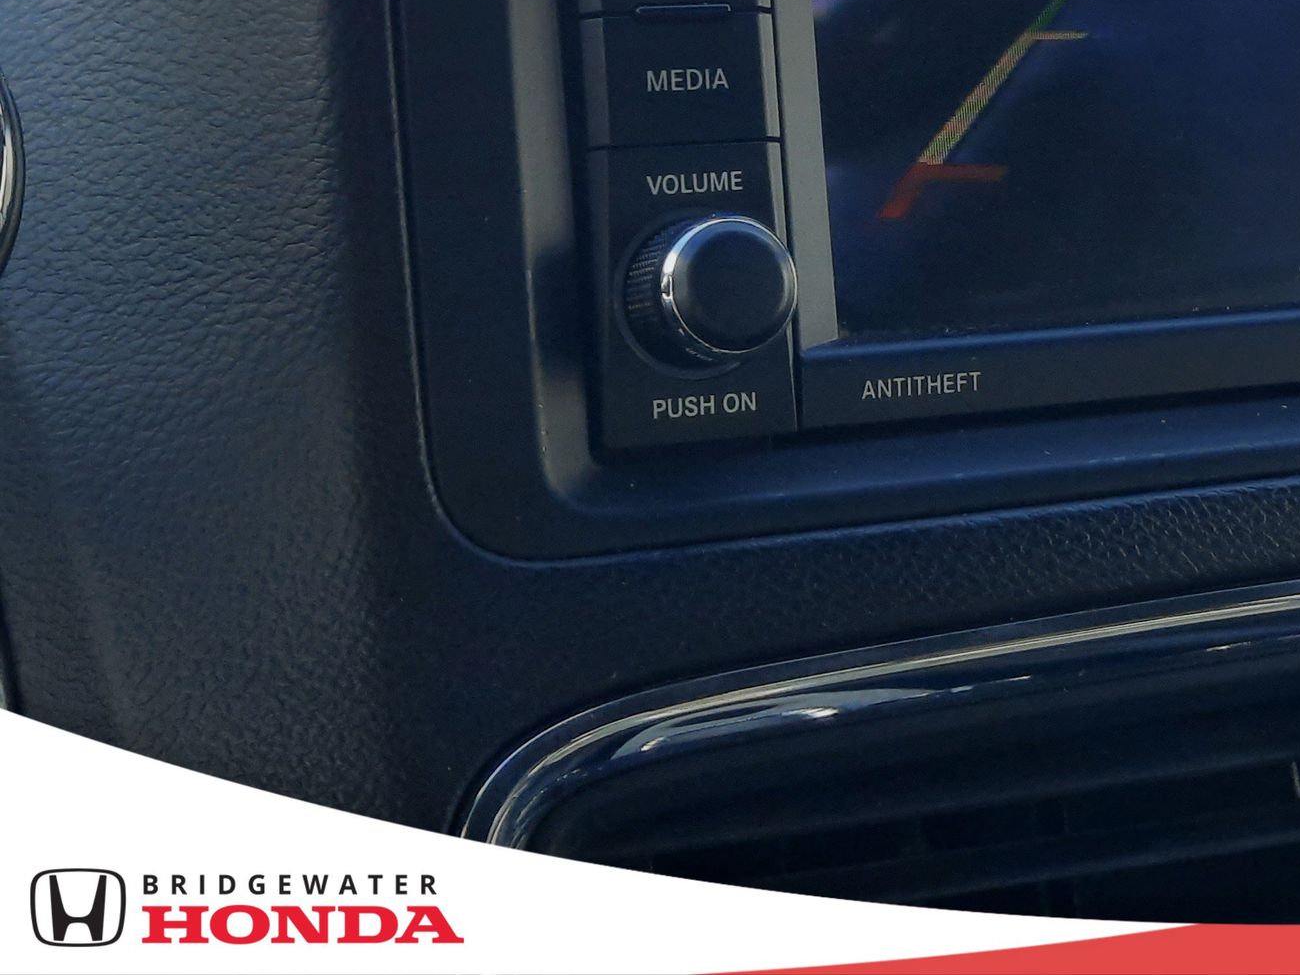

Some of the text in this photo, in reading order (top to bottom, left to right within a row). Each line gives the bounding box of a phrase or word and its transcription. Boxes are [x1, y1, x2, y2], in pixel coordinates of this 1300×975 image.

[646, 67, 730, 93] MEDIA
[646, 170, 744, 196] VOLUME
[860, 371, 982, 401] ANTITHEFT
[652, 391, 758, 420] PUSH ON
